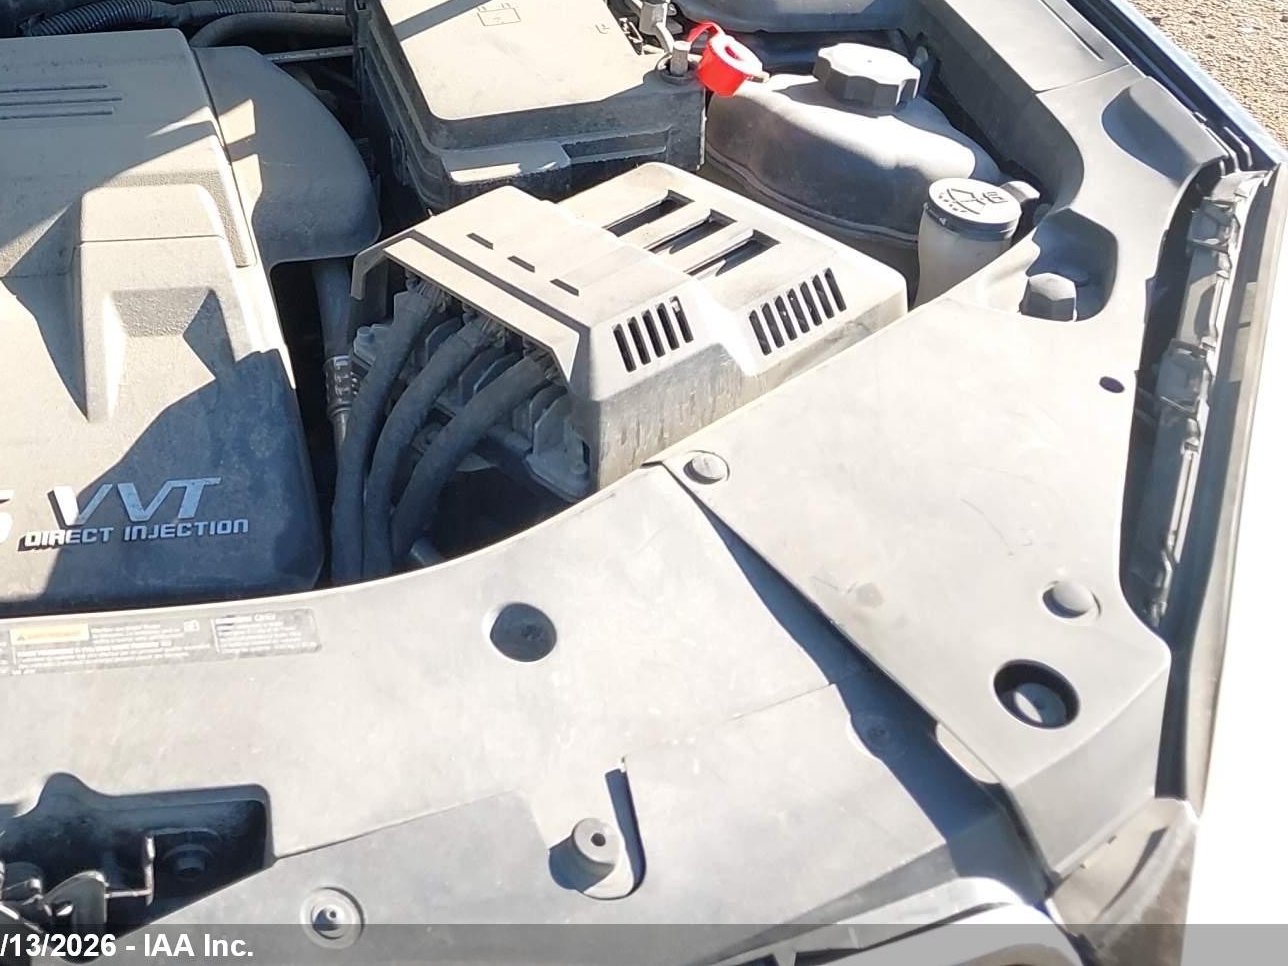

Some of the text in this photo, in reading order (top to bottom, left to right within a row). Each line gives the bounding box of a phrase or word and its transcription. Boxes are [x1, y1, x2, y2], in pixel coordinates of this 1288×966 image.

[48, 477, 223, 527] VVT
[25, 519, 249, 550] DIRECT INJECTION
